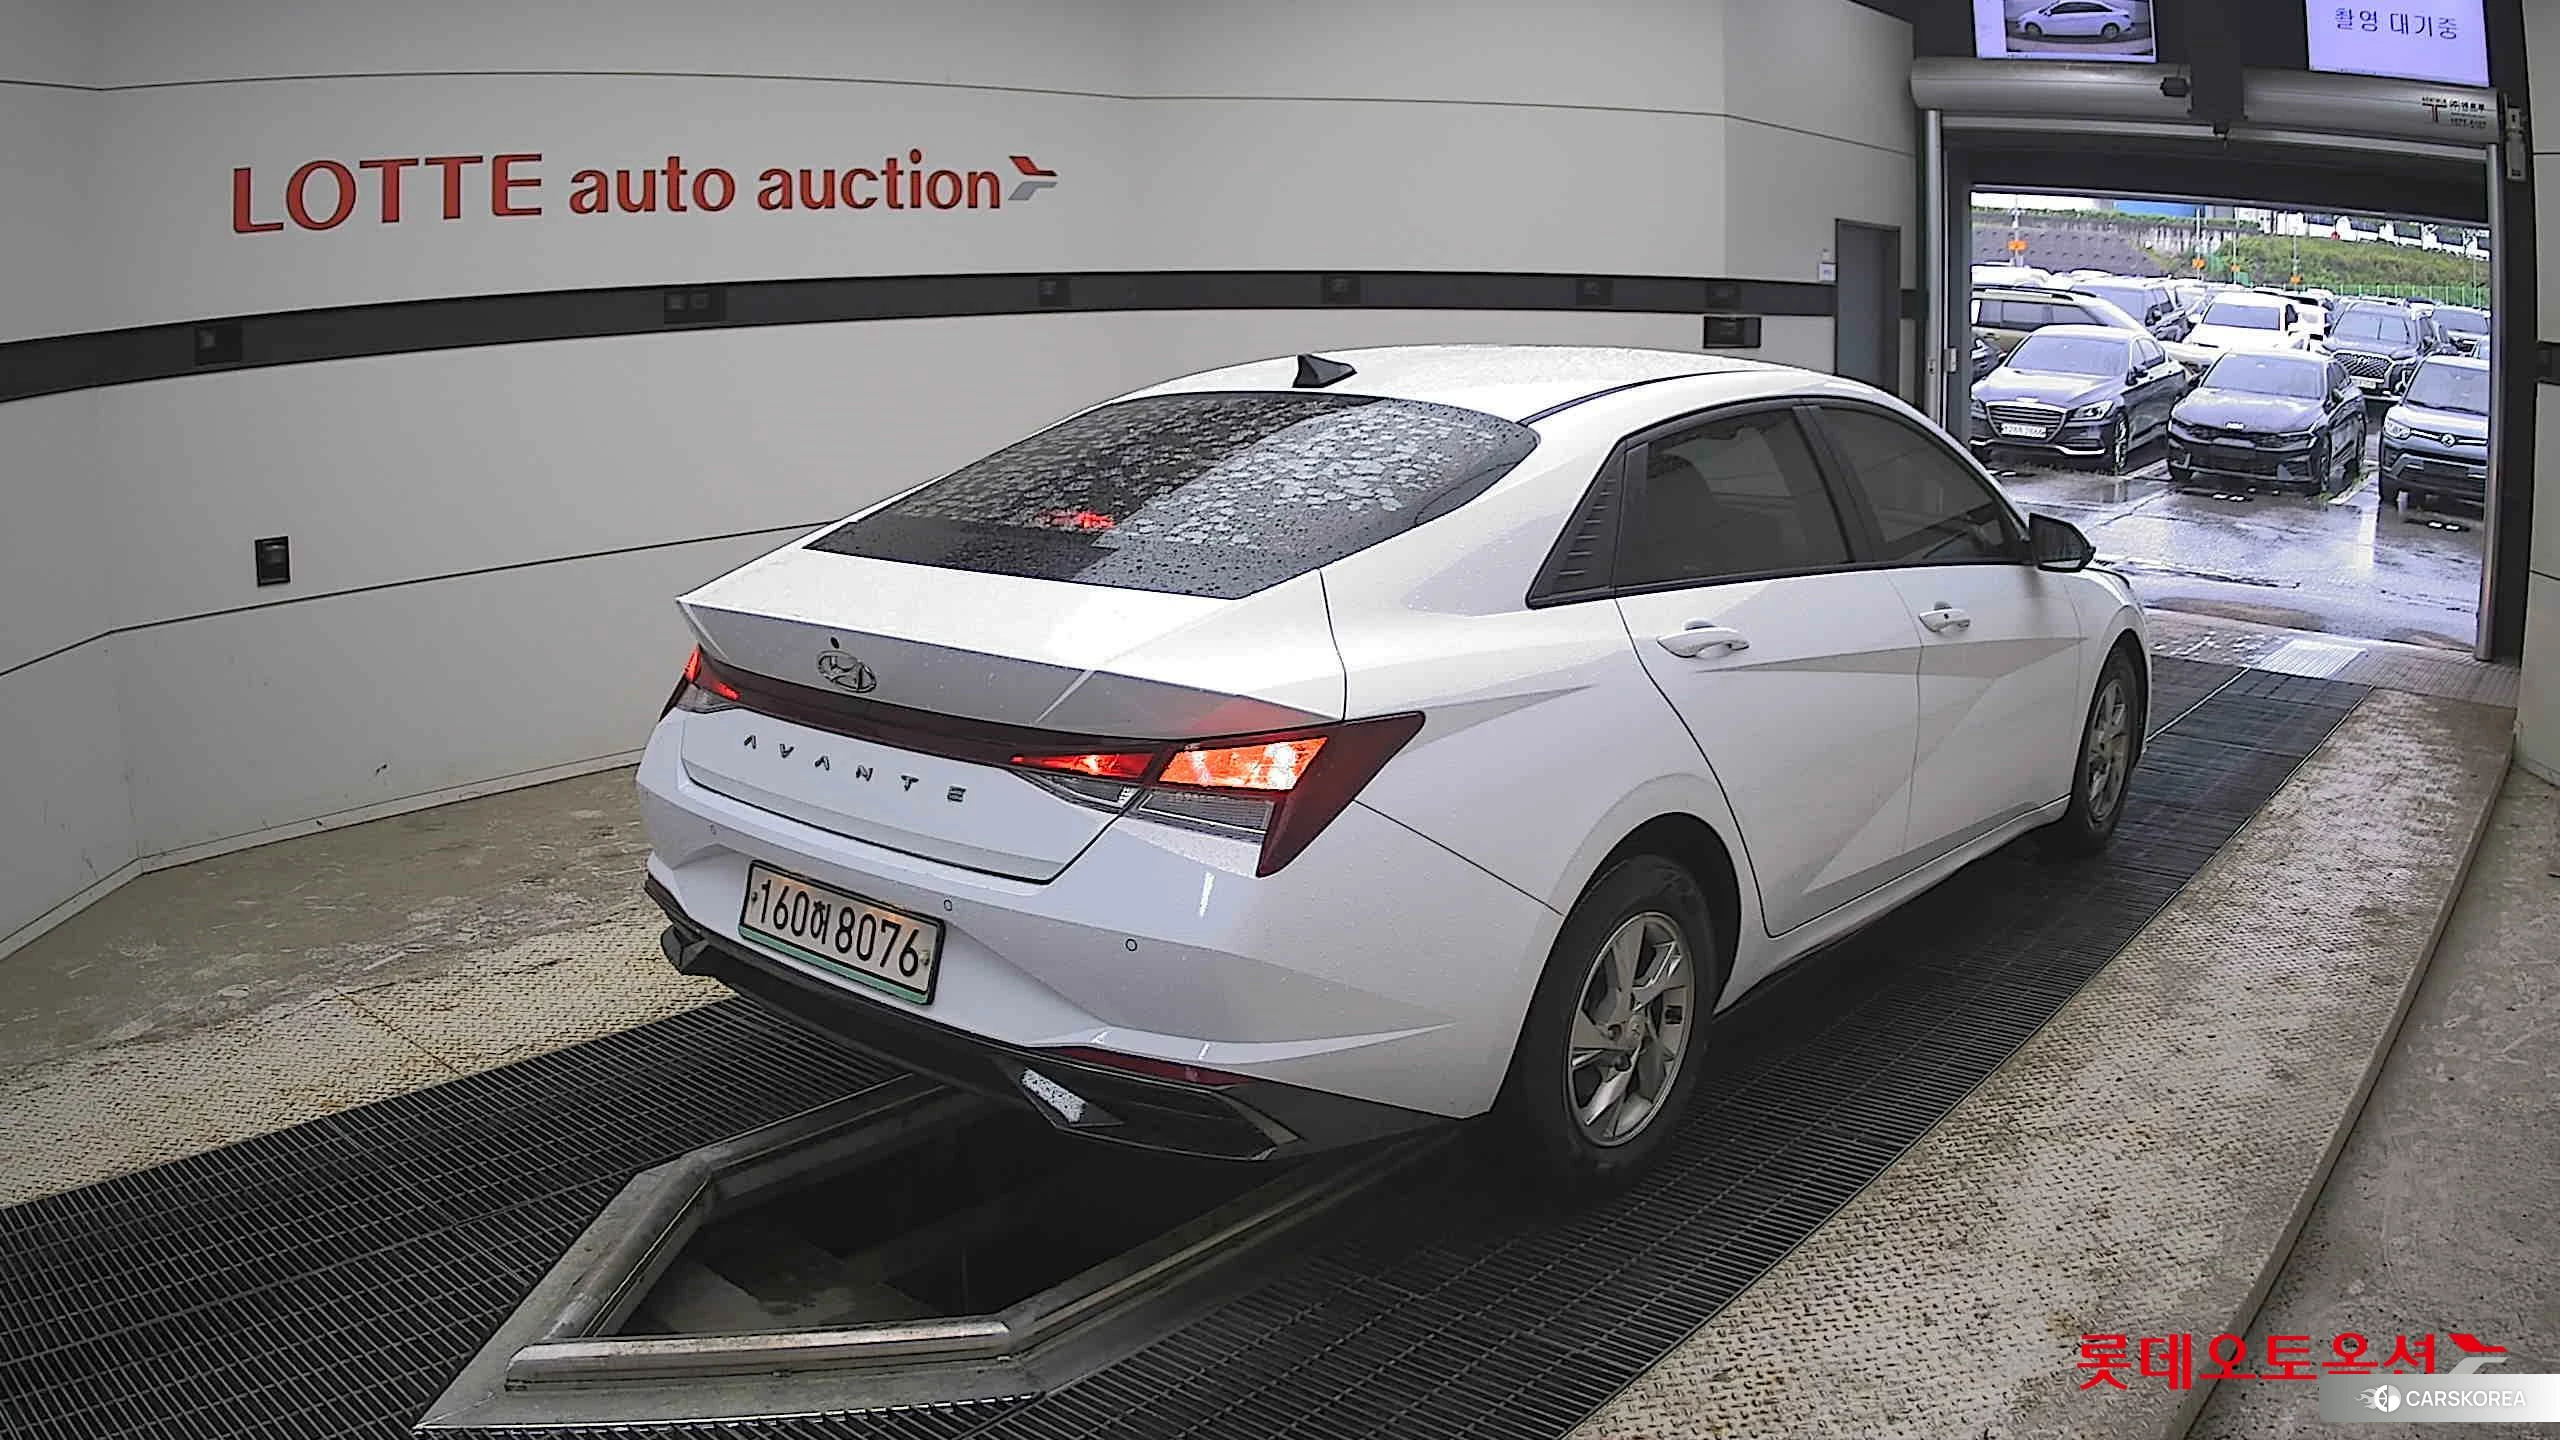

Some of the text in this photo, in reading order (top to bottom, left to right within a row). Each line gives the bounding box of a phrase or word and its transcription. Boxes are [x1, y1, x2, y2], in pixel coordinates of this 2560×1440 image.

[2335, 7, 2457, 40] 촬영 대기중
[233, 148, 1001, 233] LOTTE auto auction
[743, 734, 967, 802] AVANTE
